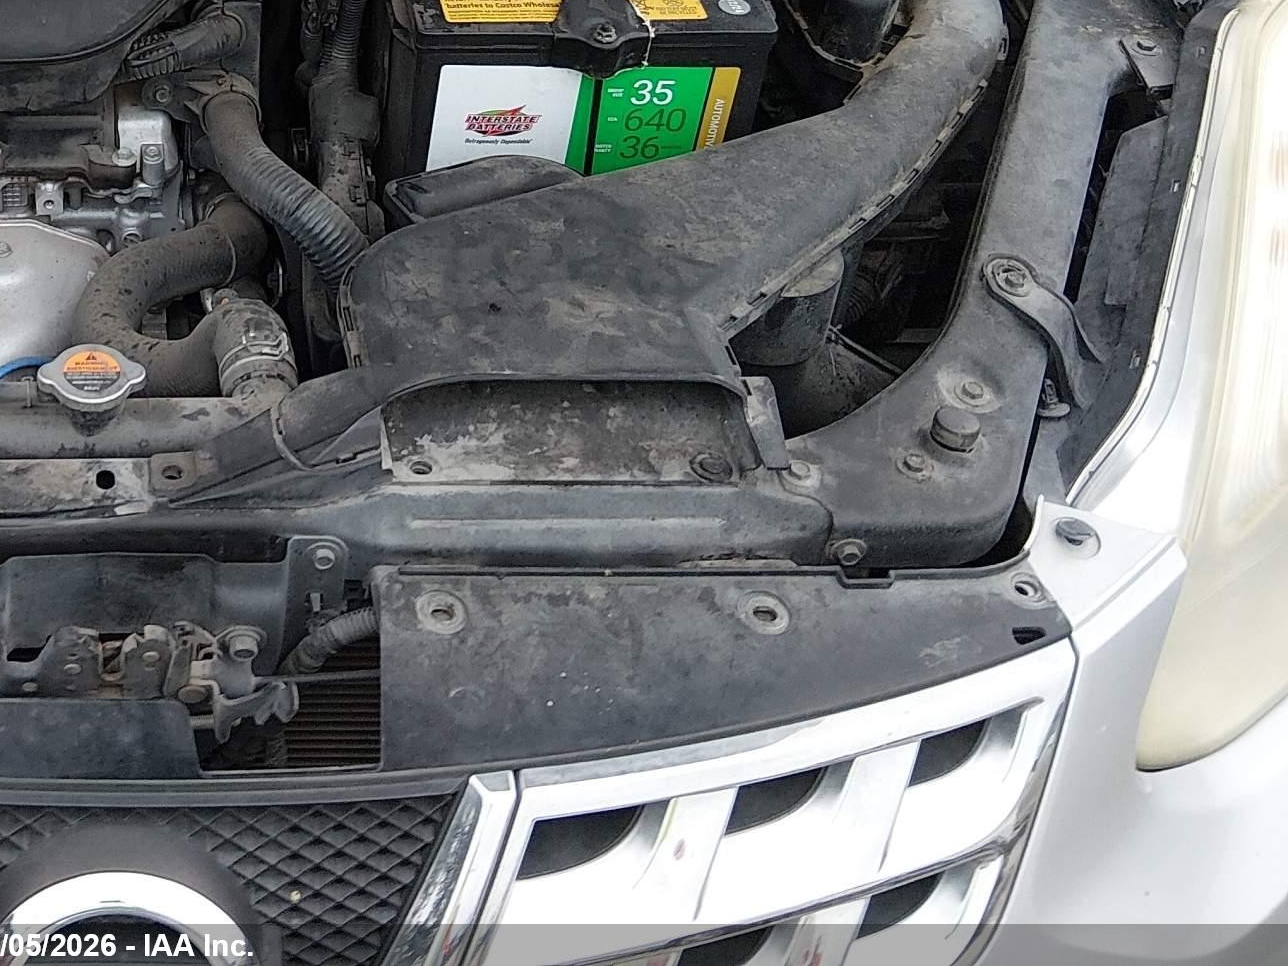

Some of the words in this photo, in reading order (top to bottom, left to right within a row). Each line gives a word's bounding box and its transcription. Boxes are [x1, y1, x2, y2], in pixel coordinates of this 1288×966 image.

[630, 79, 676, 105] 35
[465, 114, 539, 123] INTERSTATE
[465, 123, 532, 131] BATTERIES
[624, 108, 687, 132] 640
[704, 98, 725, 149] AUTOMOTIV
[619, 135, 660, 160] 36
